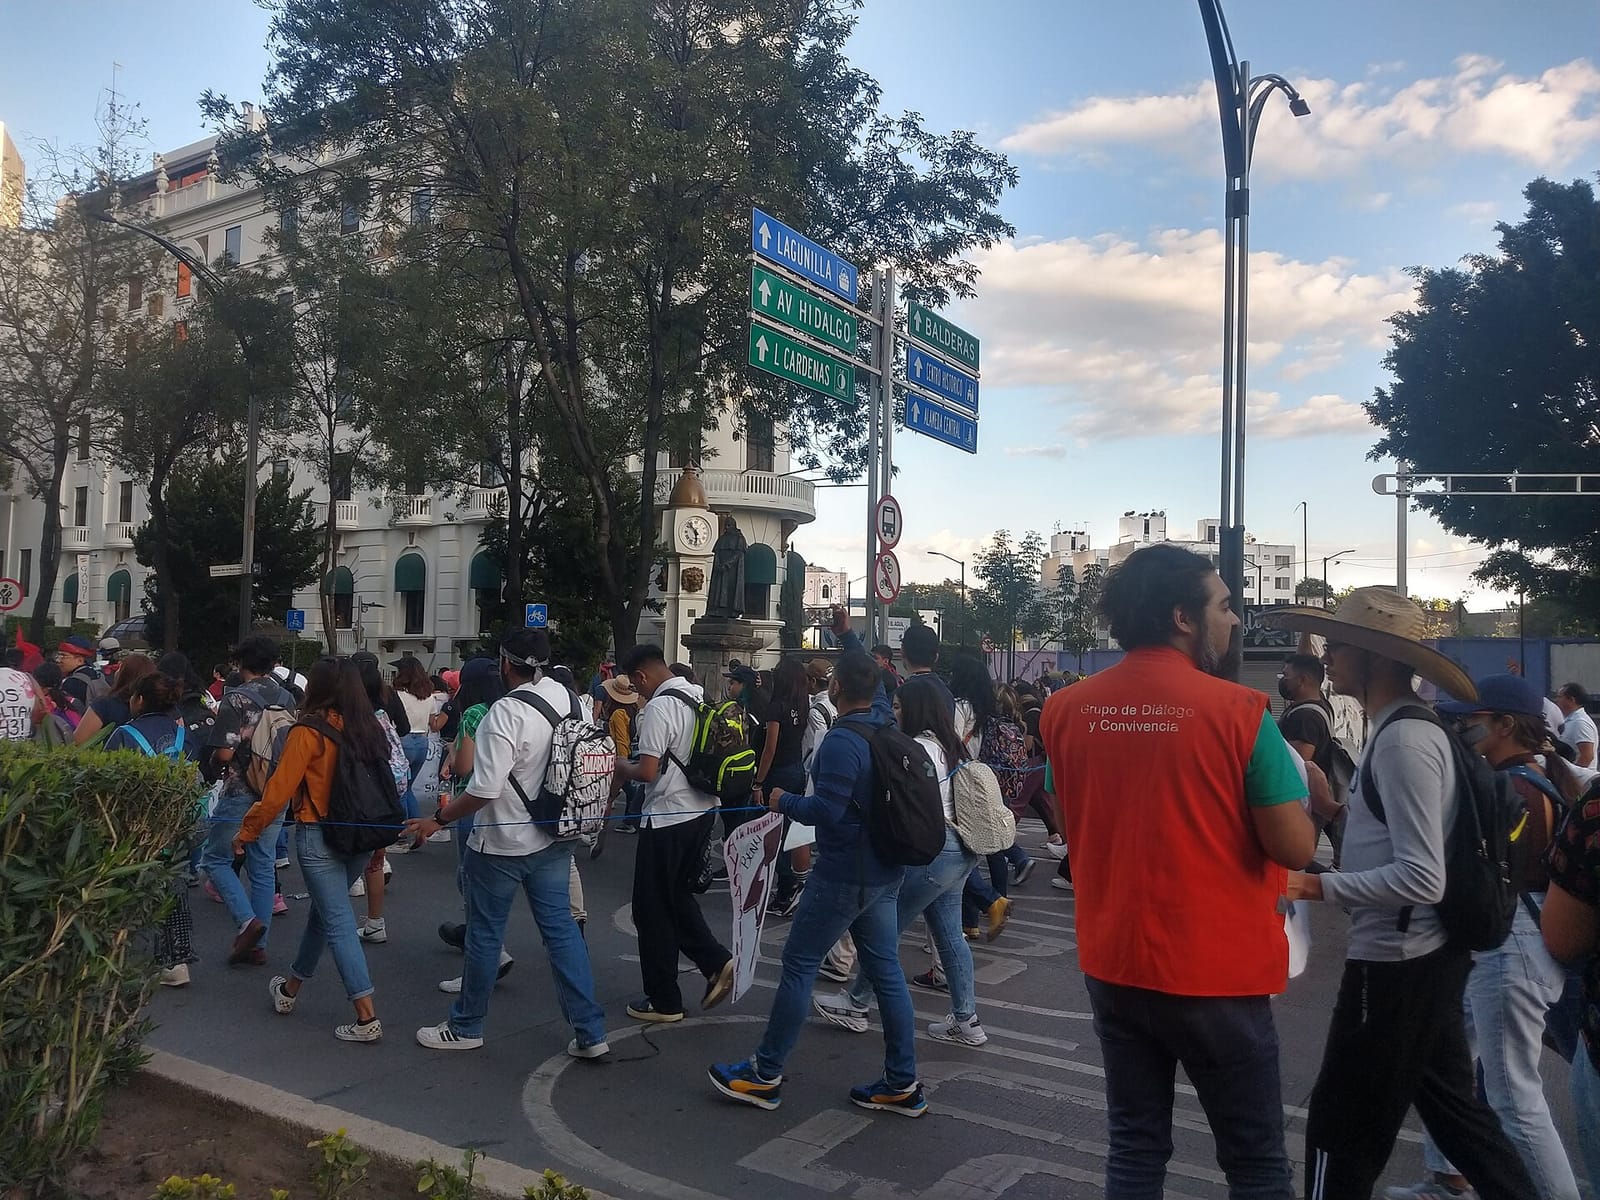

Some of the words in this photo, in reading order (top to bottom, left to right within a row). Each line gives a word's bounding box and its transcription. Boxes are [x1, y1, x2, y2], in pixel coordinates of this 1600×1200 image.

[777, 231, 832, 282] LAGUNILLA
[777, 289, 792, 316] AV
[799, 299, 851, 344] HIDALGO
[925, 317, 975, 361] BALDERAS
[773, 342, 779, 366] L
[783, 347, 830, 387] CARDENAS
[923, 407, 943, 432] ALAMEDA
[943, 415, 961, 439] CENTRAL
[294, 612, 299, 620] E
[1080, 704, 1118, 717] Grupo
[1121, 705, 1137, 716] de
[1141, 704, 1194, 719] Diálogo
[1088, 721, 1096, 733] y
[1100, 719, 1179, 732] Convivencia
